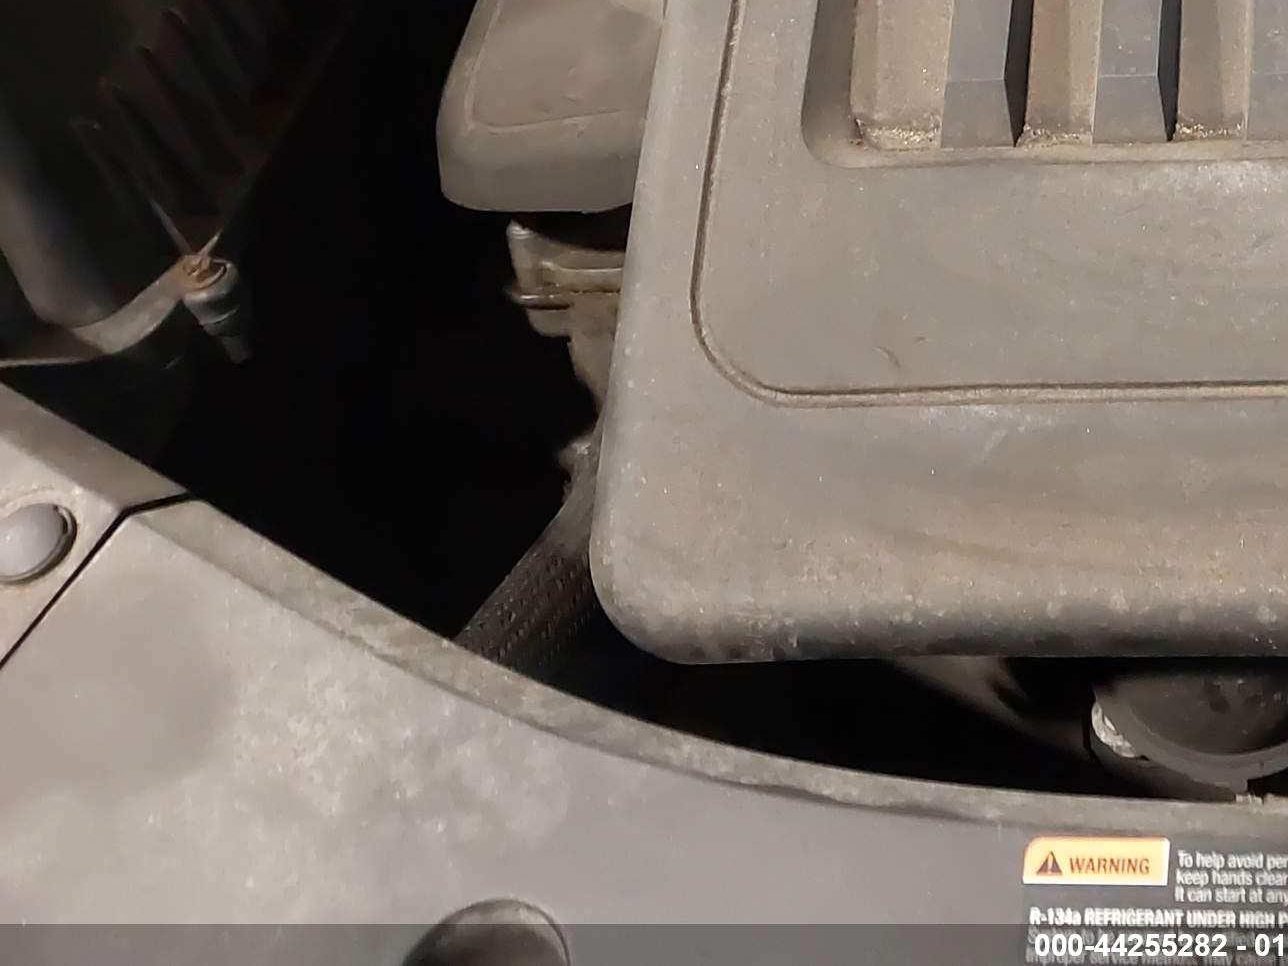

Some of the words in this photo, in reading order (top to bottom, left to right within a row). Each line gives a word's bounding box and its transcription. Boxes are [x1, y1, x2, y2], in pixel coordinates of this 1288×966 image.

[1069, 857, 1151, 876] WARNING
[1178, 850, 1194, 869] To
[1196, 851, 1225, 871] help
[1228, 852, 1264, 869] avoid
[1175, 868, 1209, 887] keep
[1211, 869, 1253, 886] hands
[1255, 870, 1288, 886] clear
[1174, 885, 1184, 902] It
[1187, 887, 1212, 903] can
[1215, 886, 1246, 903] start
[1249, 887, 1263, 903] at
[1028, 906, 1082, 926] R-134a
[1084, 908, 1185, 928] REFRIGERANT
[1186, 910, 1236, 929] UNDER
[1239, 911, 1276, 930] HIGH
